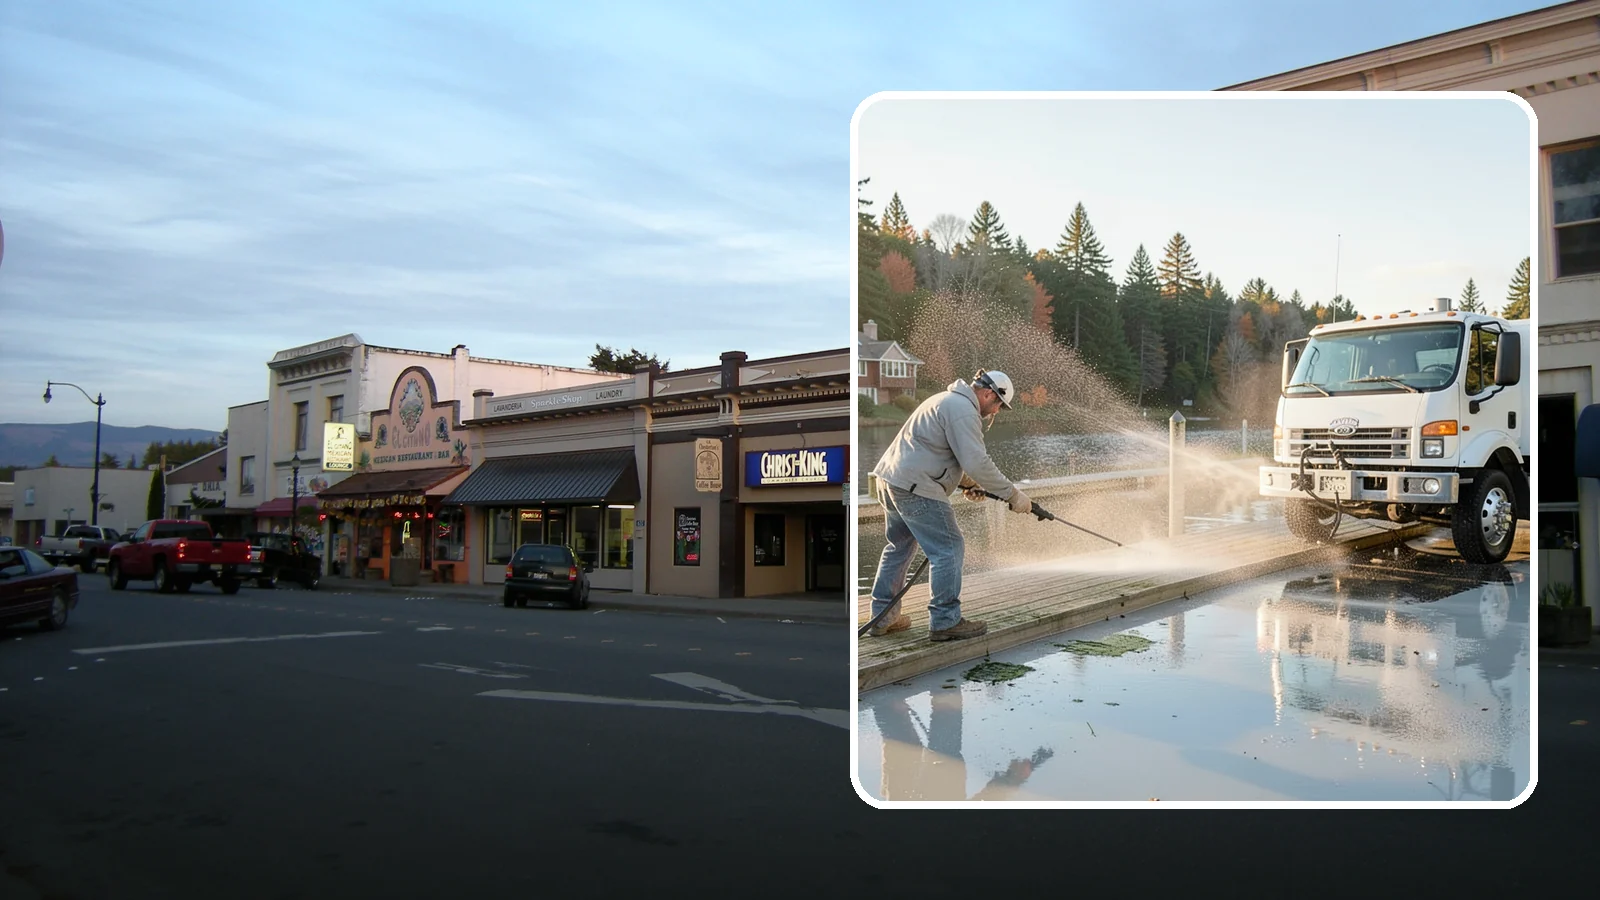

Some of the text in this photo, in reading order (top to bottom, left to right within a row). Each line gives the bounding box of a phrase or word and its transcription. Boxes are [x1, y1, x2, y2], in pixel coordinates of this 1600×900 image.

[562, 394, 582, 405] Shop
[595, 389, 623, 400] LAUNDRY
[493, 402, 522, 412] LAVANDERIA
[397, 451, 433, 463] RESTAURANT
[438, 450, 450, 459] BAR
[799, 450, 827, 476] KING
